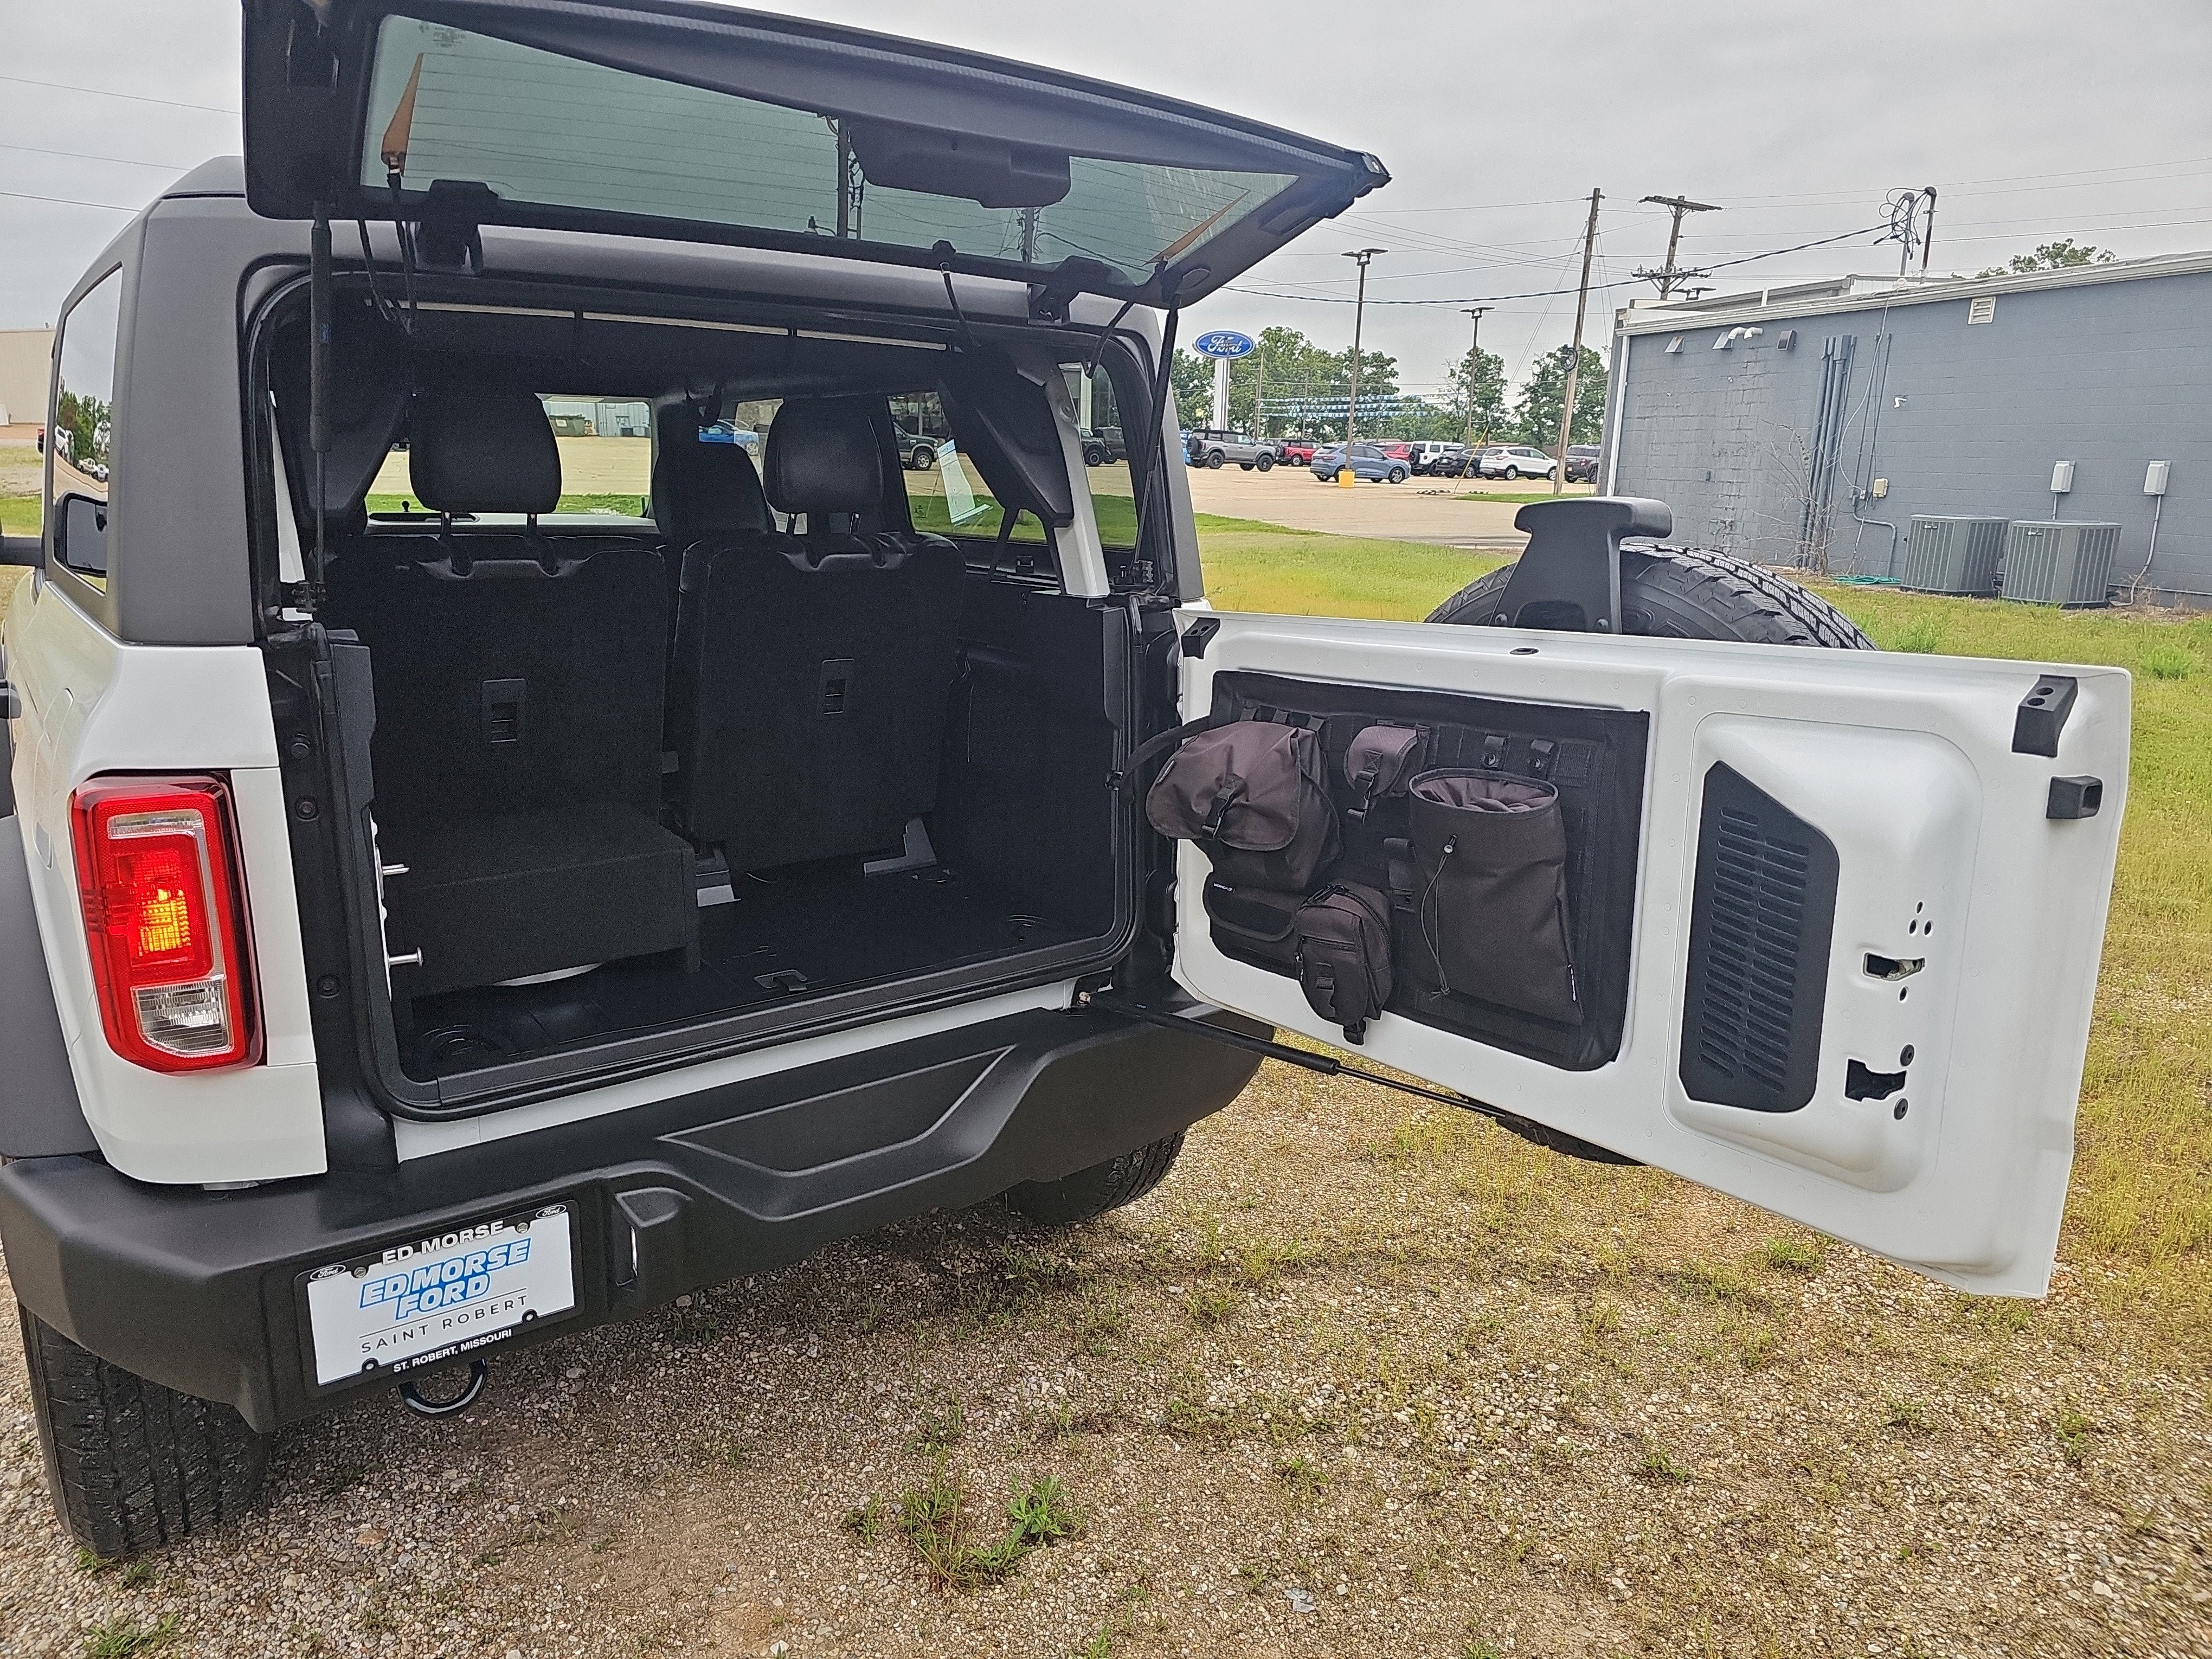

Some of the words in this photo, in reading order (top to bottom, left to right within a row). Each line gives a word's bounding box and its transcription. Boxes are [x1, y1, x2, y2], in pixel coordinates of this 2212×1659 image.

[1207, 336, 1243, 352] Ford
[542, 1206, 560, 1217] Ford
[382, 1245, 414, 1265] ED
[421, 1220, 504, 1255] MORSE
[318, 1269, 339, 1278] Ford
[360, 1273, 409, 1308] ED
[410, 1238, 531, 1293] MORSE
[396, 1271, 490, 1320] FORD
[362, 1324, 429, 1353] SAINT
[442, 1295, 527, 1329] ROBERT
[394, 1361, 410, 1373] ST.
[412, 1346, 458, 1367] ROBERT,
[460, 1329, 512, 1352] MISSOURI
